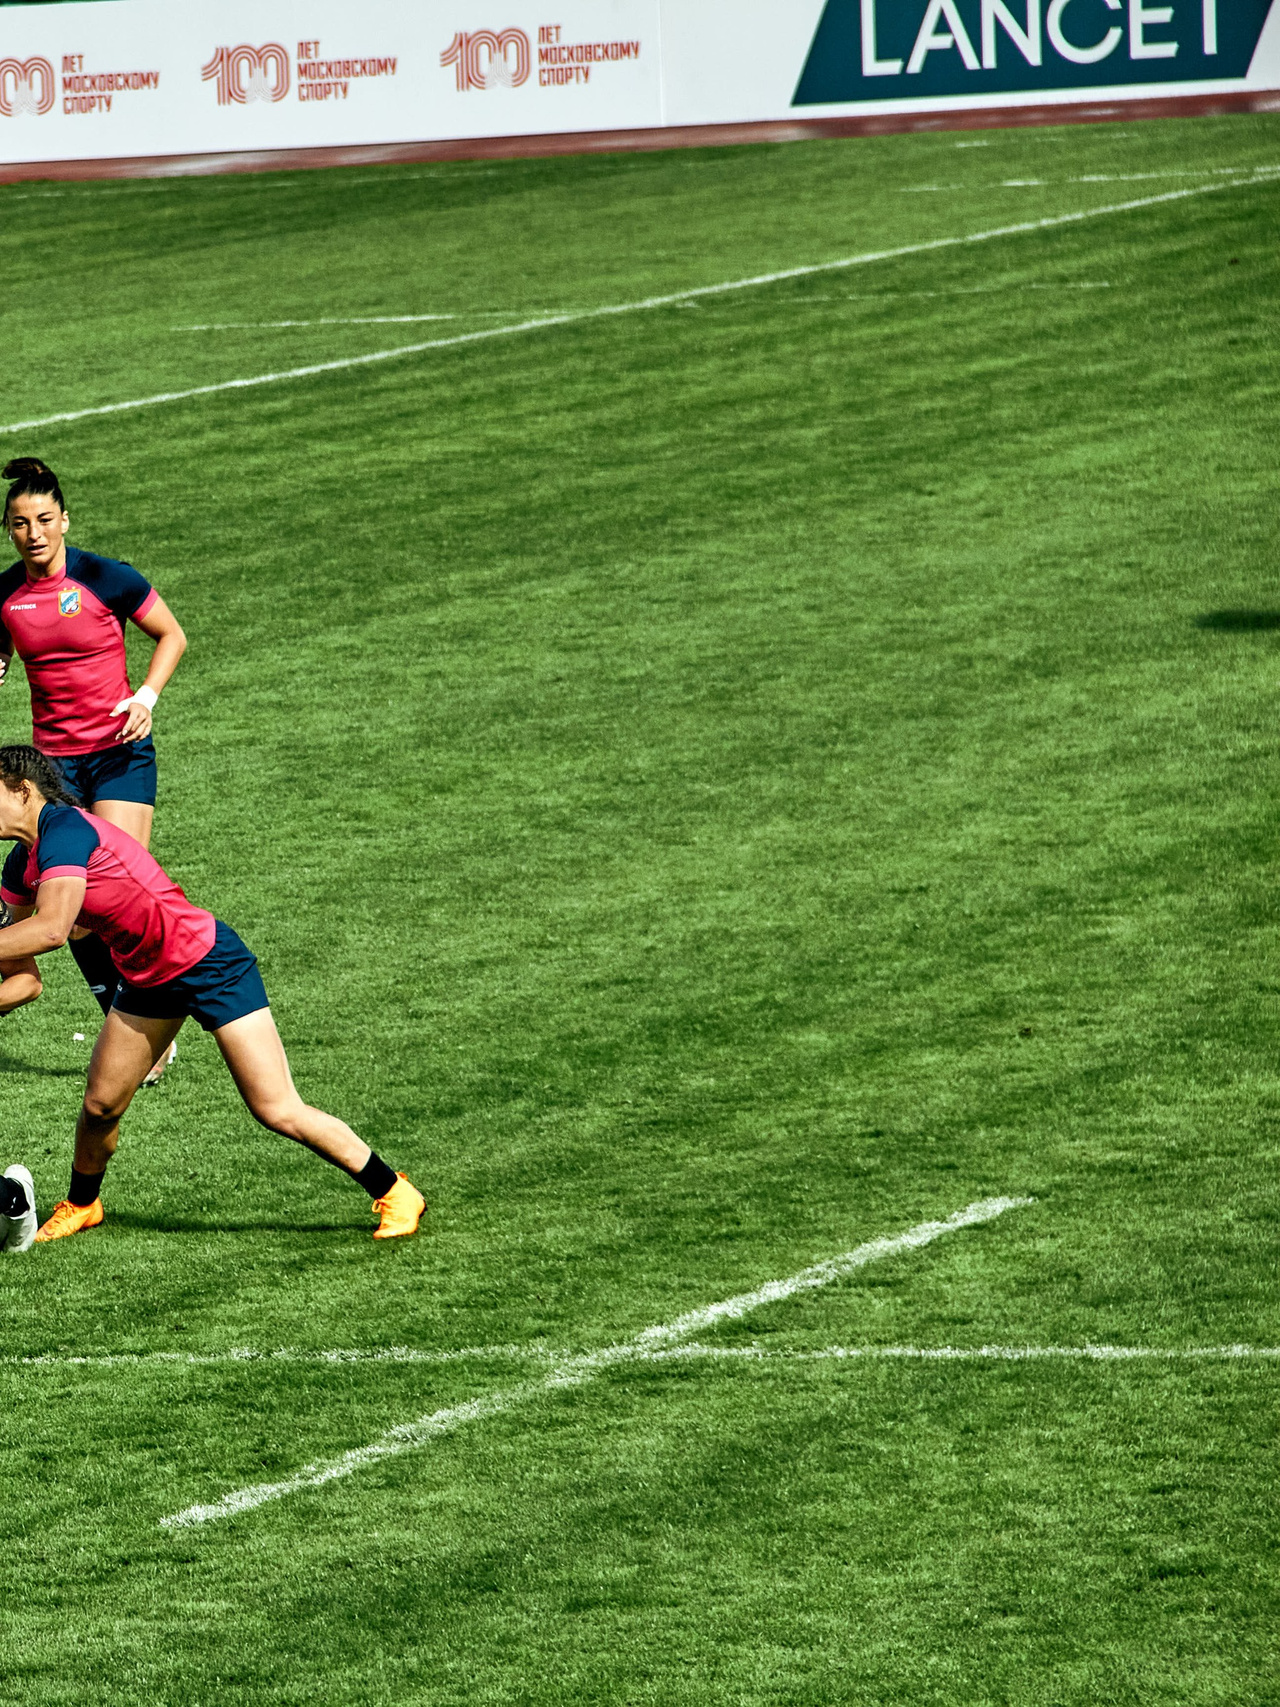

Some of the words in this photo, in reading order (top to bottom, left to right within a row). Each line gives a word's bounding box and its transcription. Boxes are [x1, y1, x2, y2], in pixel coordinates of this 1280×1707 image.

[538, 25, 562, 44] ЛЕТ
[297, 40, 320, 60] ЛЕТ
[440, 27, 531, 92] 100
[538, 40, 640, 66] МОСКОВСКОМУ
[62, 54, 84, 73] ЛЕТ
[201, 43, 290, 106] 100
[297, 57, 398, 81] МОСКОВСКОМУ
[62, 71, 160, 94] МОСКОВСКОМУ
[539, 65, 590, 87] СПОРТУ
[298, 81, 350, 101] СПОРТУ
[63, 94, 113, 115] СПОРТУ
